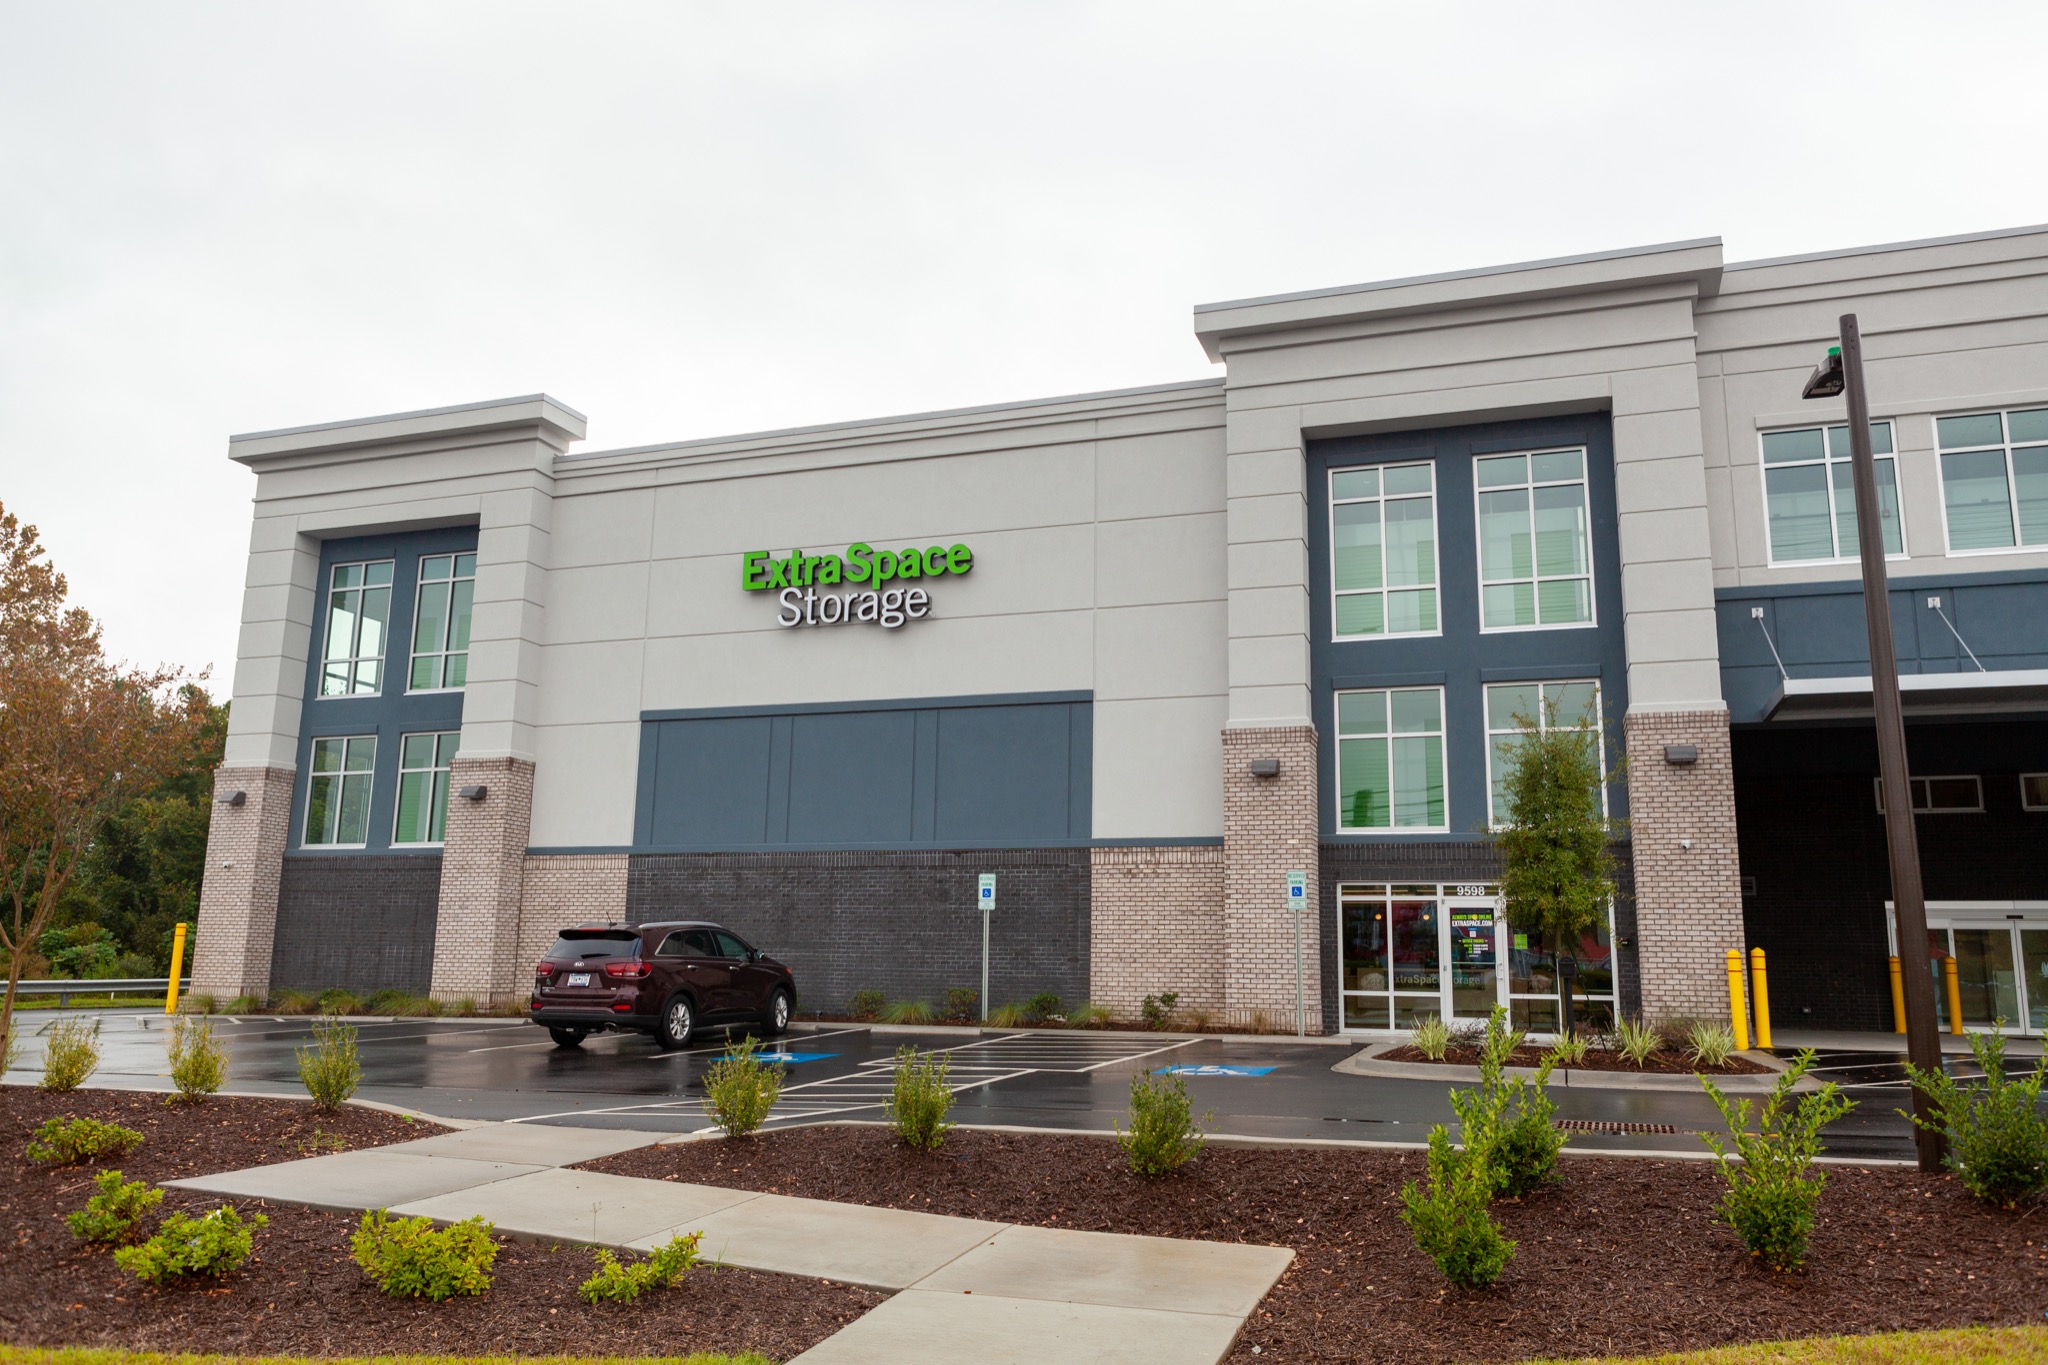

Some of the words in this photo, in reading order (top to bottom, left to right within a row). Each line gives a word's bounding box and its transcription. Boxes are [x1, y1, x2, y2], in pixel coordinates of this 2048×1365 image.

[743, 542, 973, 591] ExtraSpace
[777, 587, 929, 627] Storage
[1457, 886, 1485, 896] 9598
